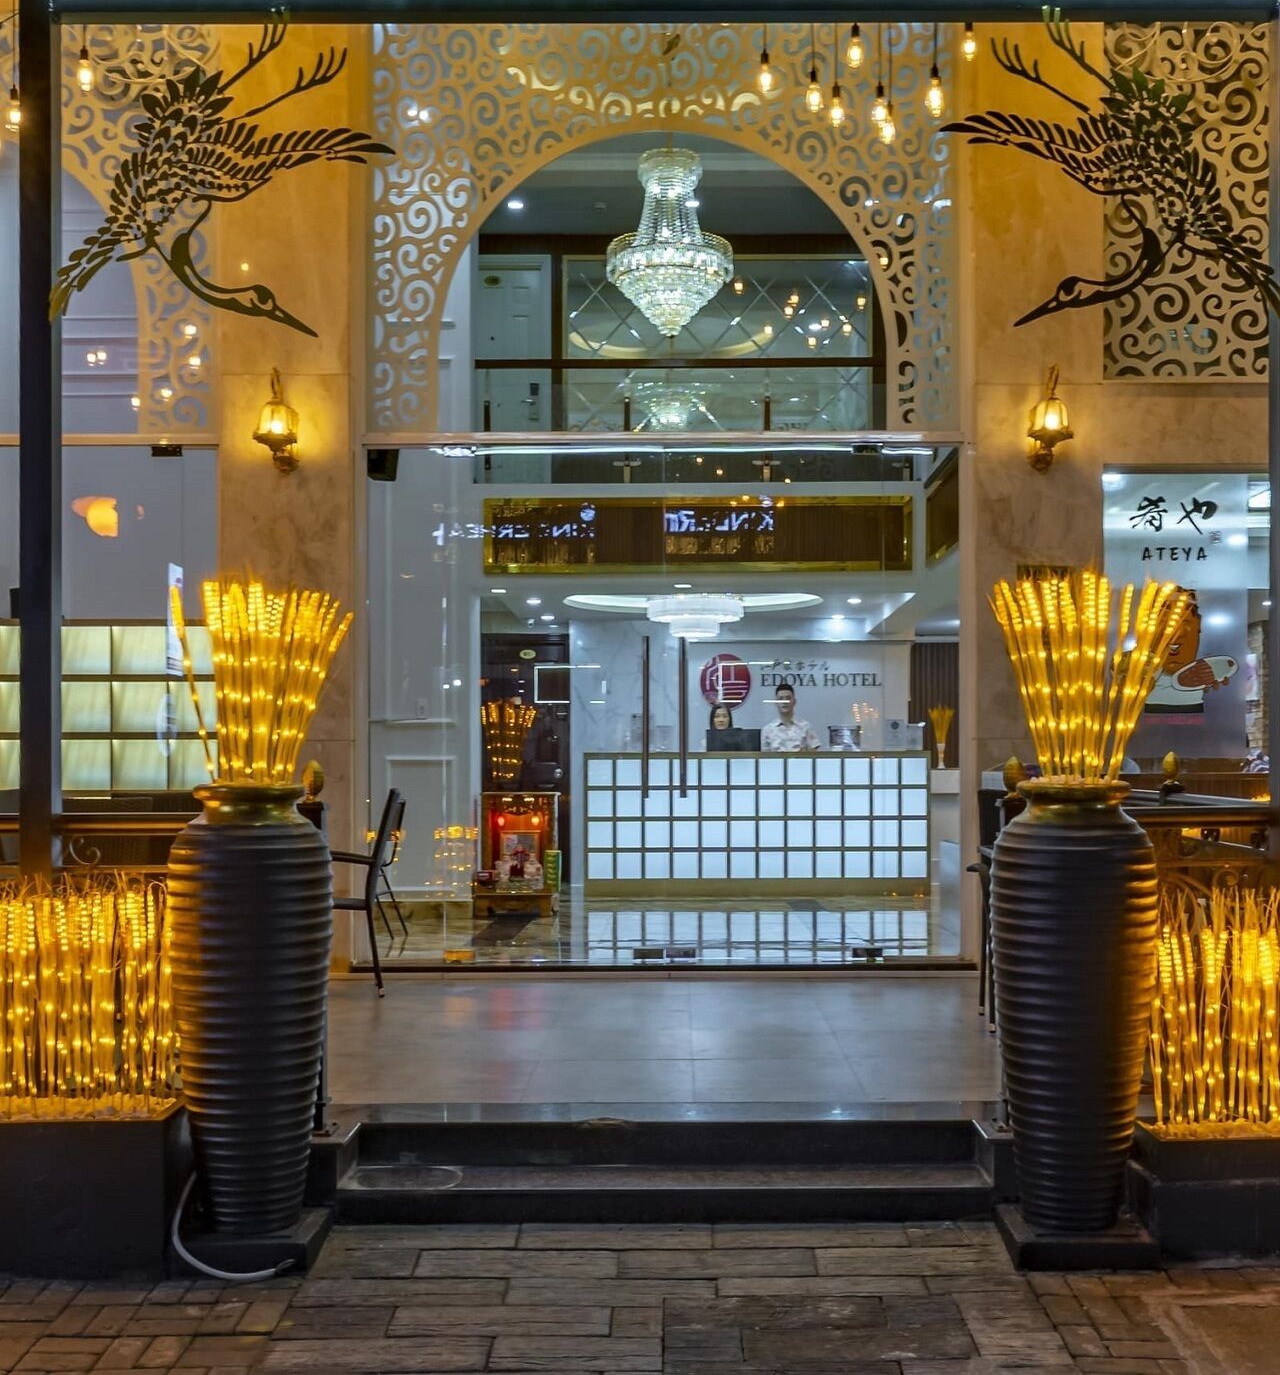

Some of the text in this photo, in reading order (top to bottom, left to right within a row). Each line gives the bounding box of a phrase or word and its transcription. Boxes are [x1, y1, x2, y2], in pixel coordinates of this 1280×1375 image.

[1141, 546, 1208, 562] ATEYA
[760, 673, 882, 687] EDOYA HOTEL
